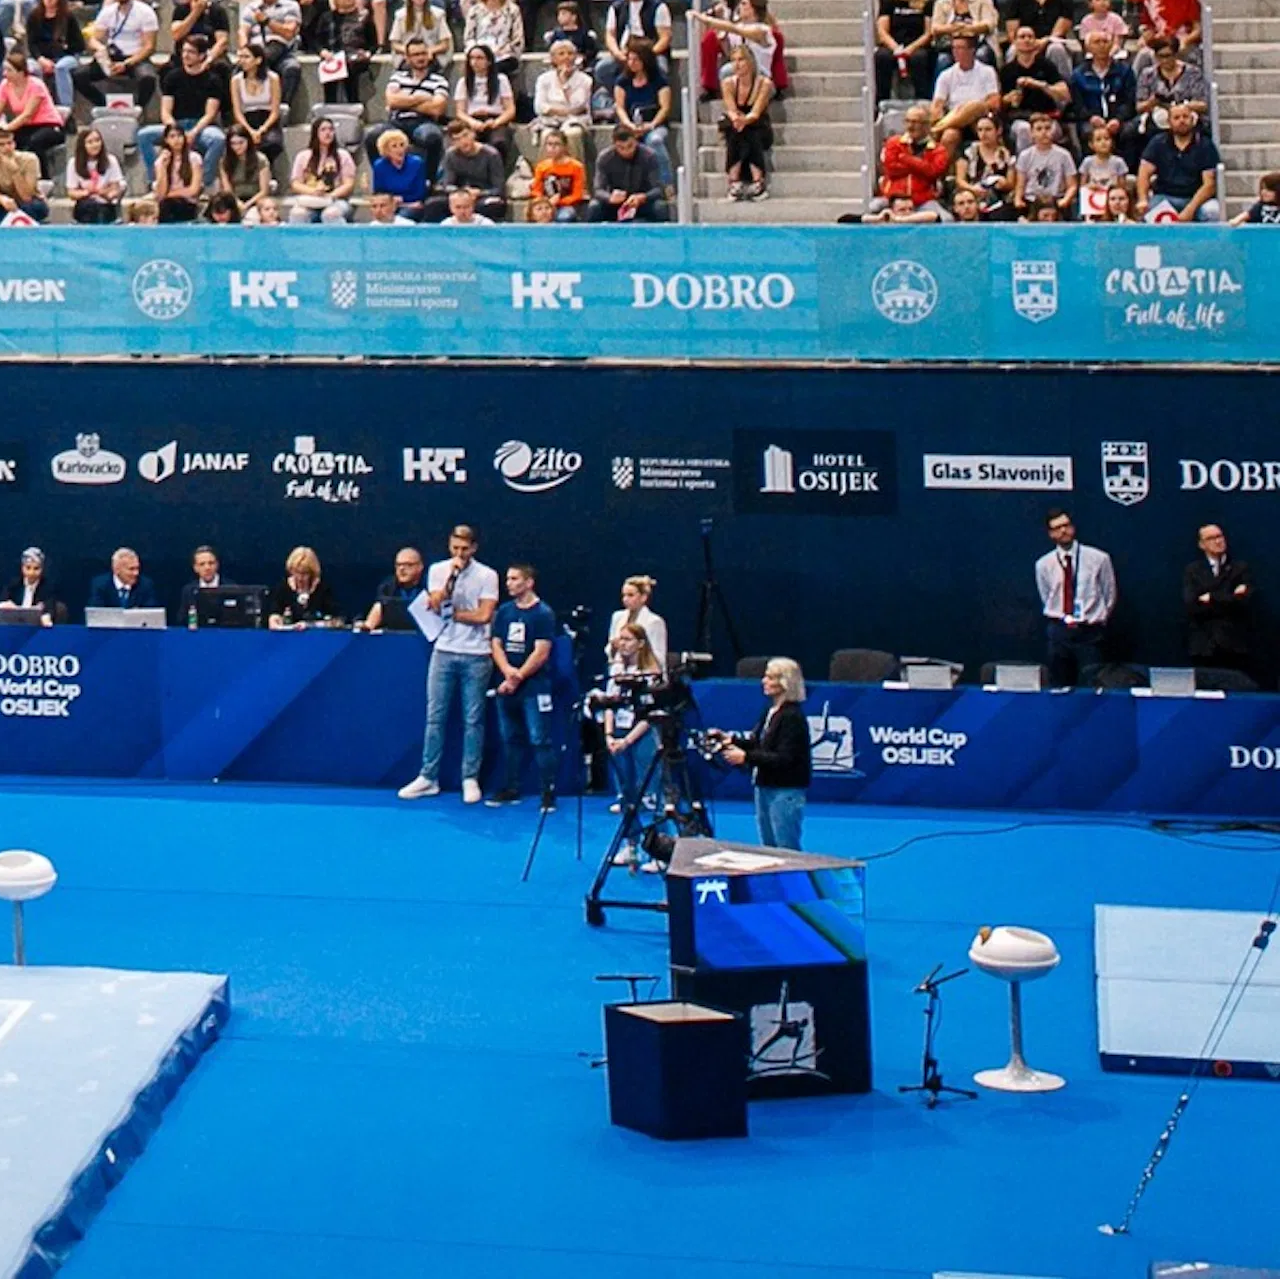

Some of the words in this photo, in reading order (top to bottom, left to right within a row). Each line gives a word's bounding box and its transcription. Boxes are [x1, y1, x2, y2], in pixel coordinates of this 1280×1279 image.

[630, 272, 795, 309] DOBRO
[1105, 266, 1241, 296] CROATIA
[182, 453, 249, 474] JANAF
[273, 451, 373, 476] CROATIA
[813, 453, 865, 467] HOTEL
[798, 471, 879, 496] OSIJEK
[931, 461, 972, 479] Glas
[978, 463, 1065, 484] Slavonije
[43, 679, 81, 700] Cup
[0, 698, 70, 716] OSIJEK
[869, 726, 926, 744] World
[928, 729, 966, 749] Cup
[882, 748, 955, 767] OSIJEK
